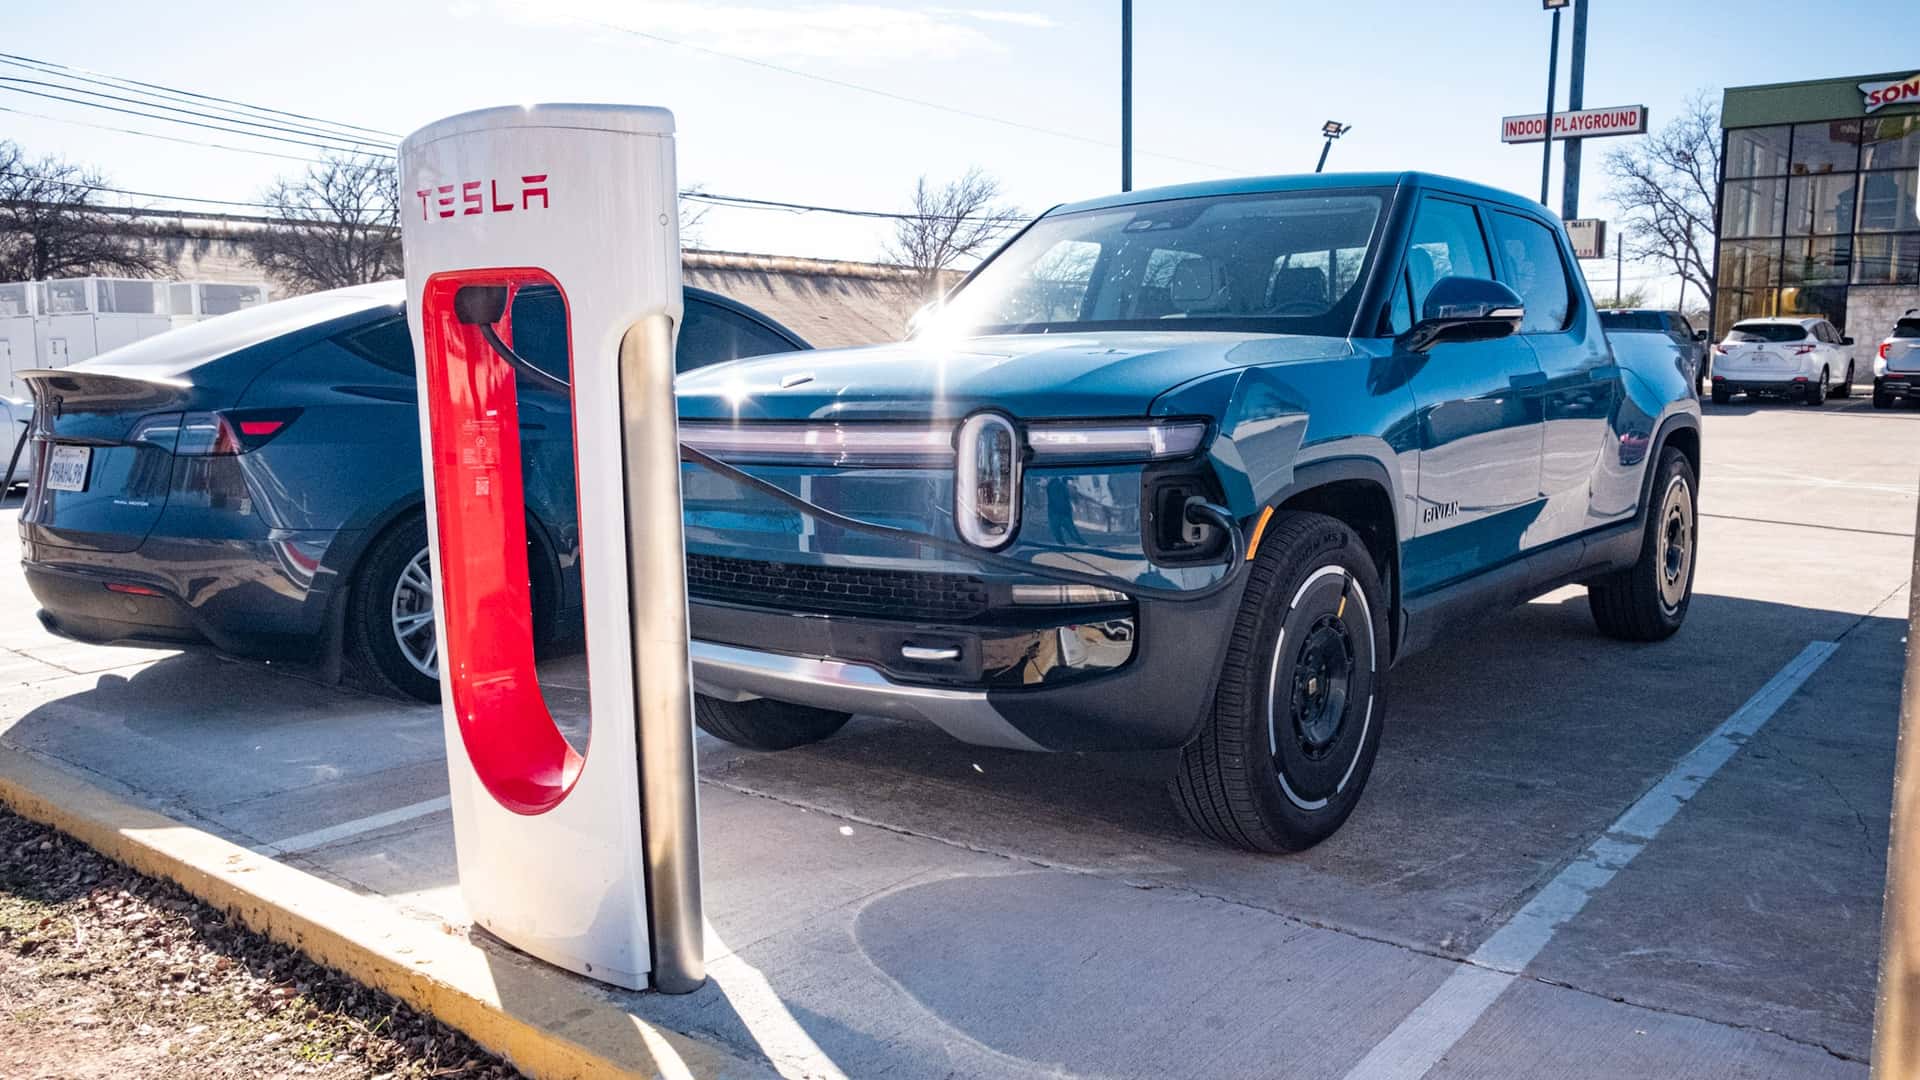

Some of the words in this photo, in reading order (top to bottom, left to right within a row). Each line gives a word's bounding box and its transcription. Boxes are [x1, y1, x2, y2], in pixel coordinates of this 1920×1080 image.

[1554, 111, 1637, 132] PLAYGROUND
[416, 174, 548, 221] TESLA
[1423, 500, 1460, 523] RIVIAN
